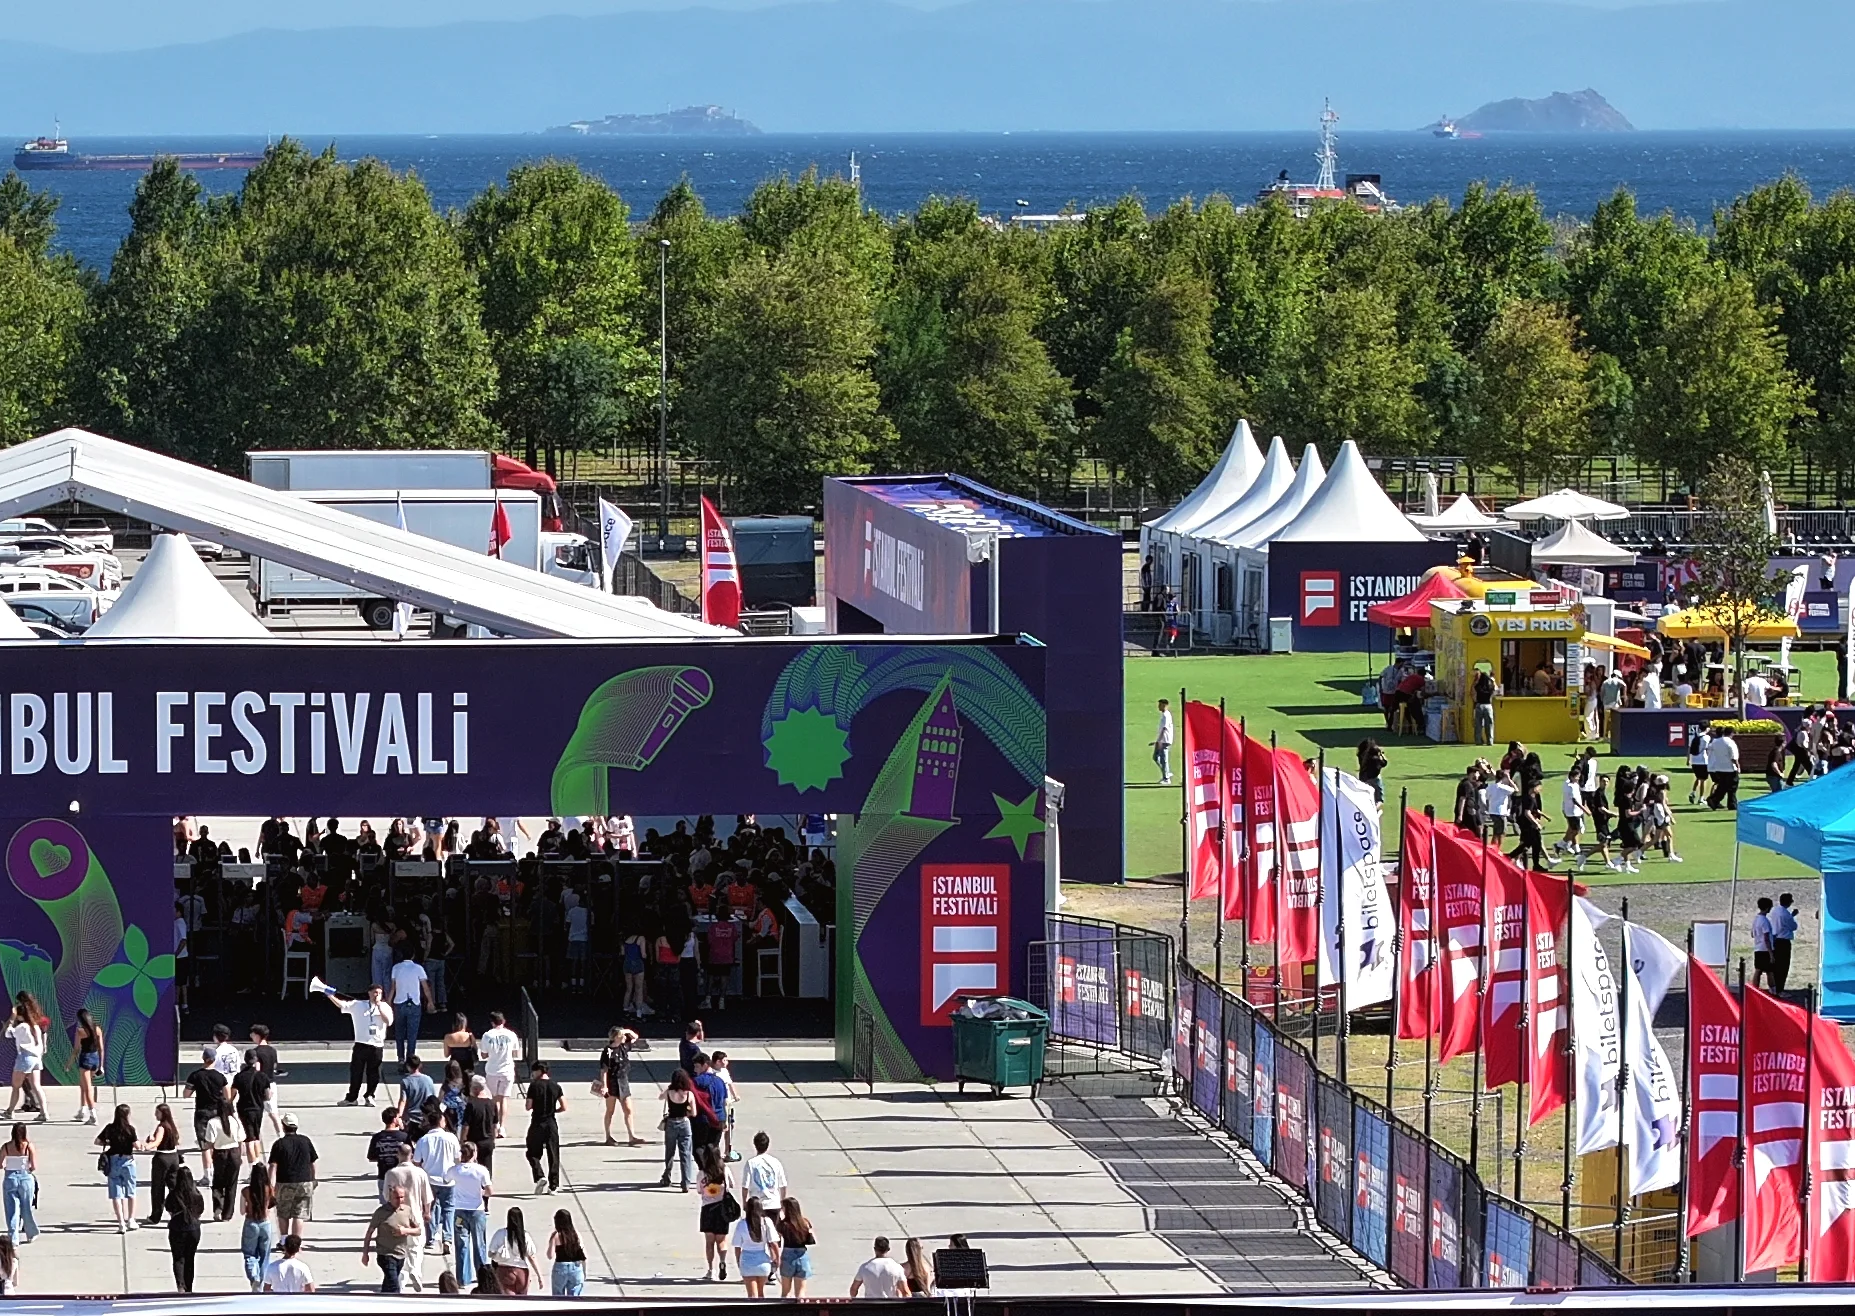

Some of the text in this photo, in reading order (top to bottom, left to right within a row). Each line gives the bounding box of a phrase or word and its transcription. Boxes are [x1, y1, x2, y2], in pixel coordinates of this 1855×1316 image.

[1350, 575, 1422, 597] iSTANBU
[1495, 617, 1575, 631] YES FRIES
[156, 691, 469, 774] FESTiVALi
[1352, 811, 1379, 931] biletspace
[933, 876, 997, 895] iSTANBUL
[933, 897, 998, 915] FESTiVALi
[1700, 1024, 1739, 1045] iSTAN
[1699, 1045, 1739, 1064] FESTi
